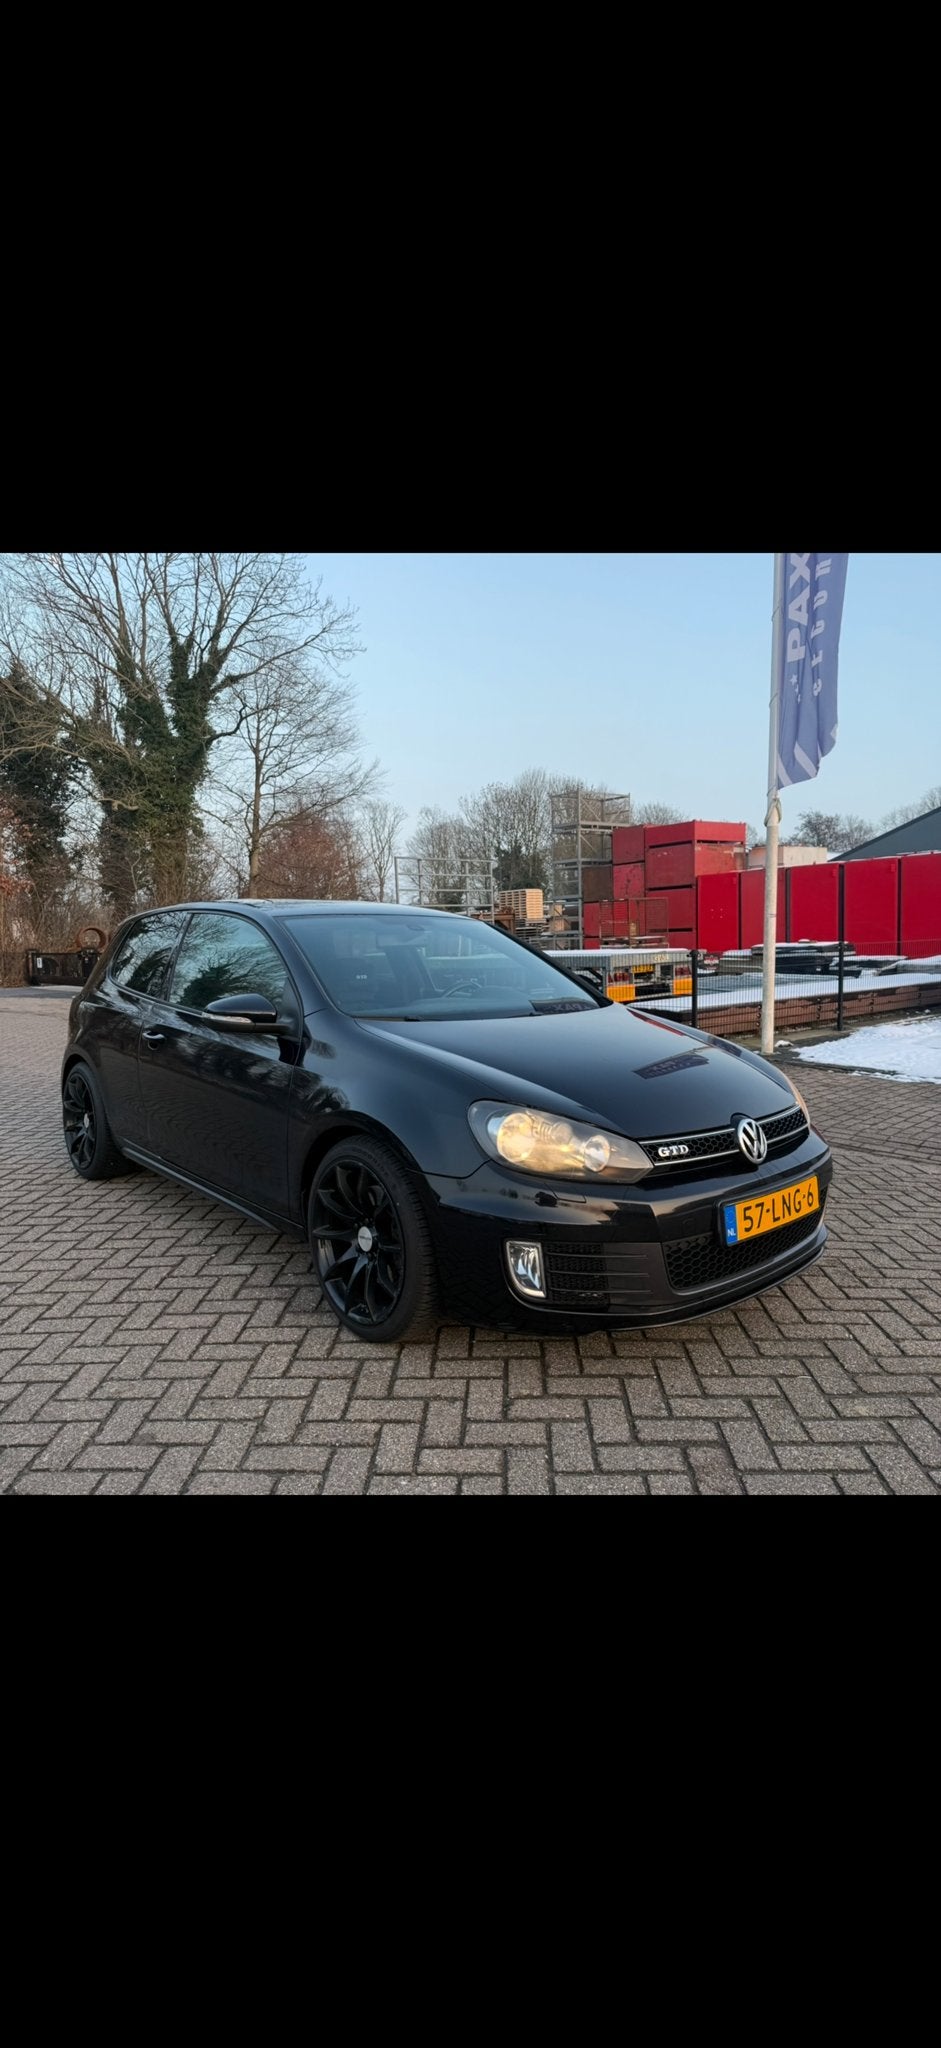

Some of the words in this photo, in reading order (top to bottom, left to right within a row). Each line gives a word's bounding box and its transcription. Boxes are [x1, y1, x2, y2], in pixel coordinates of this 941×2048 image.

[657, 1144, 689, 1157] GTD
[743, 1183, 815, 1233] 57-LNG-6
[727, 1228, 736, 1238] NL
